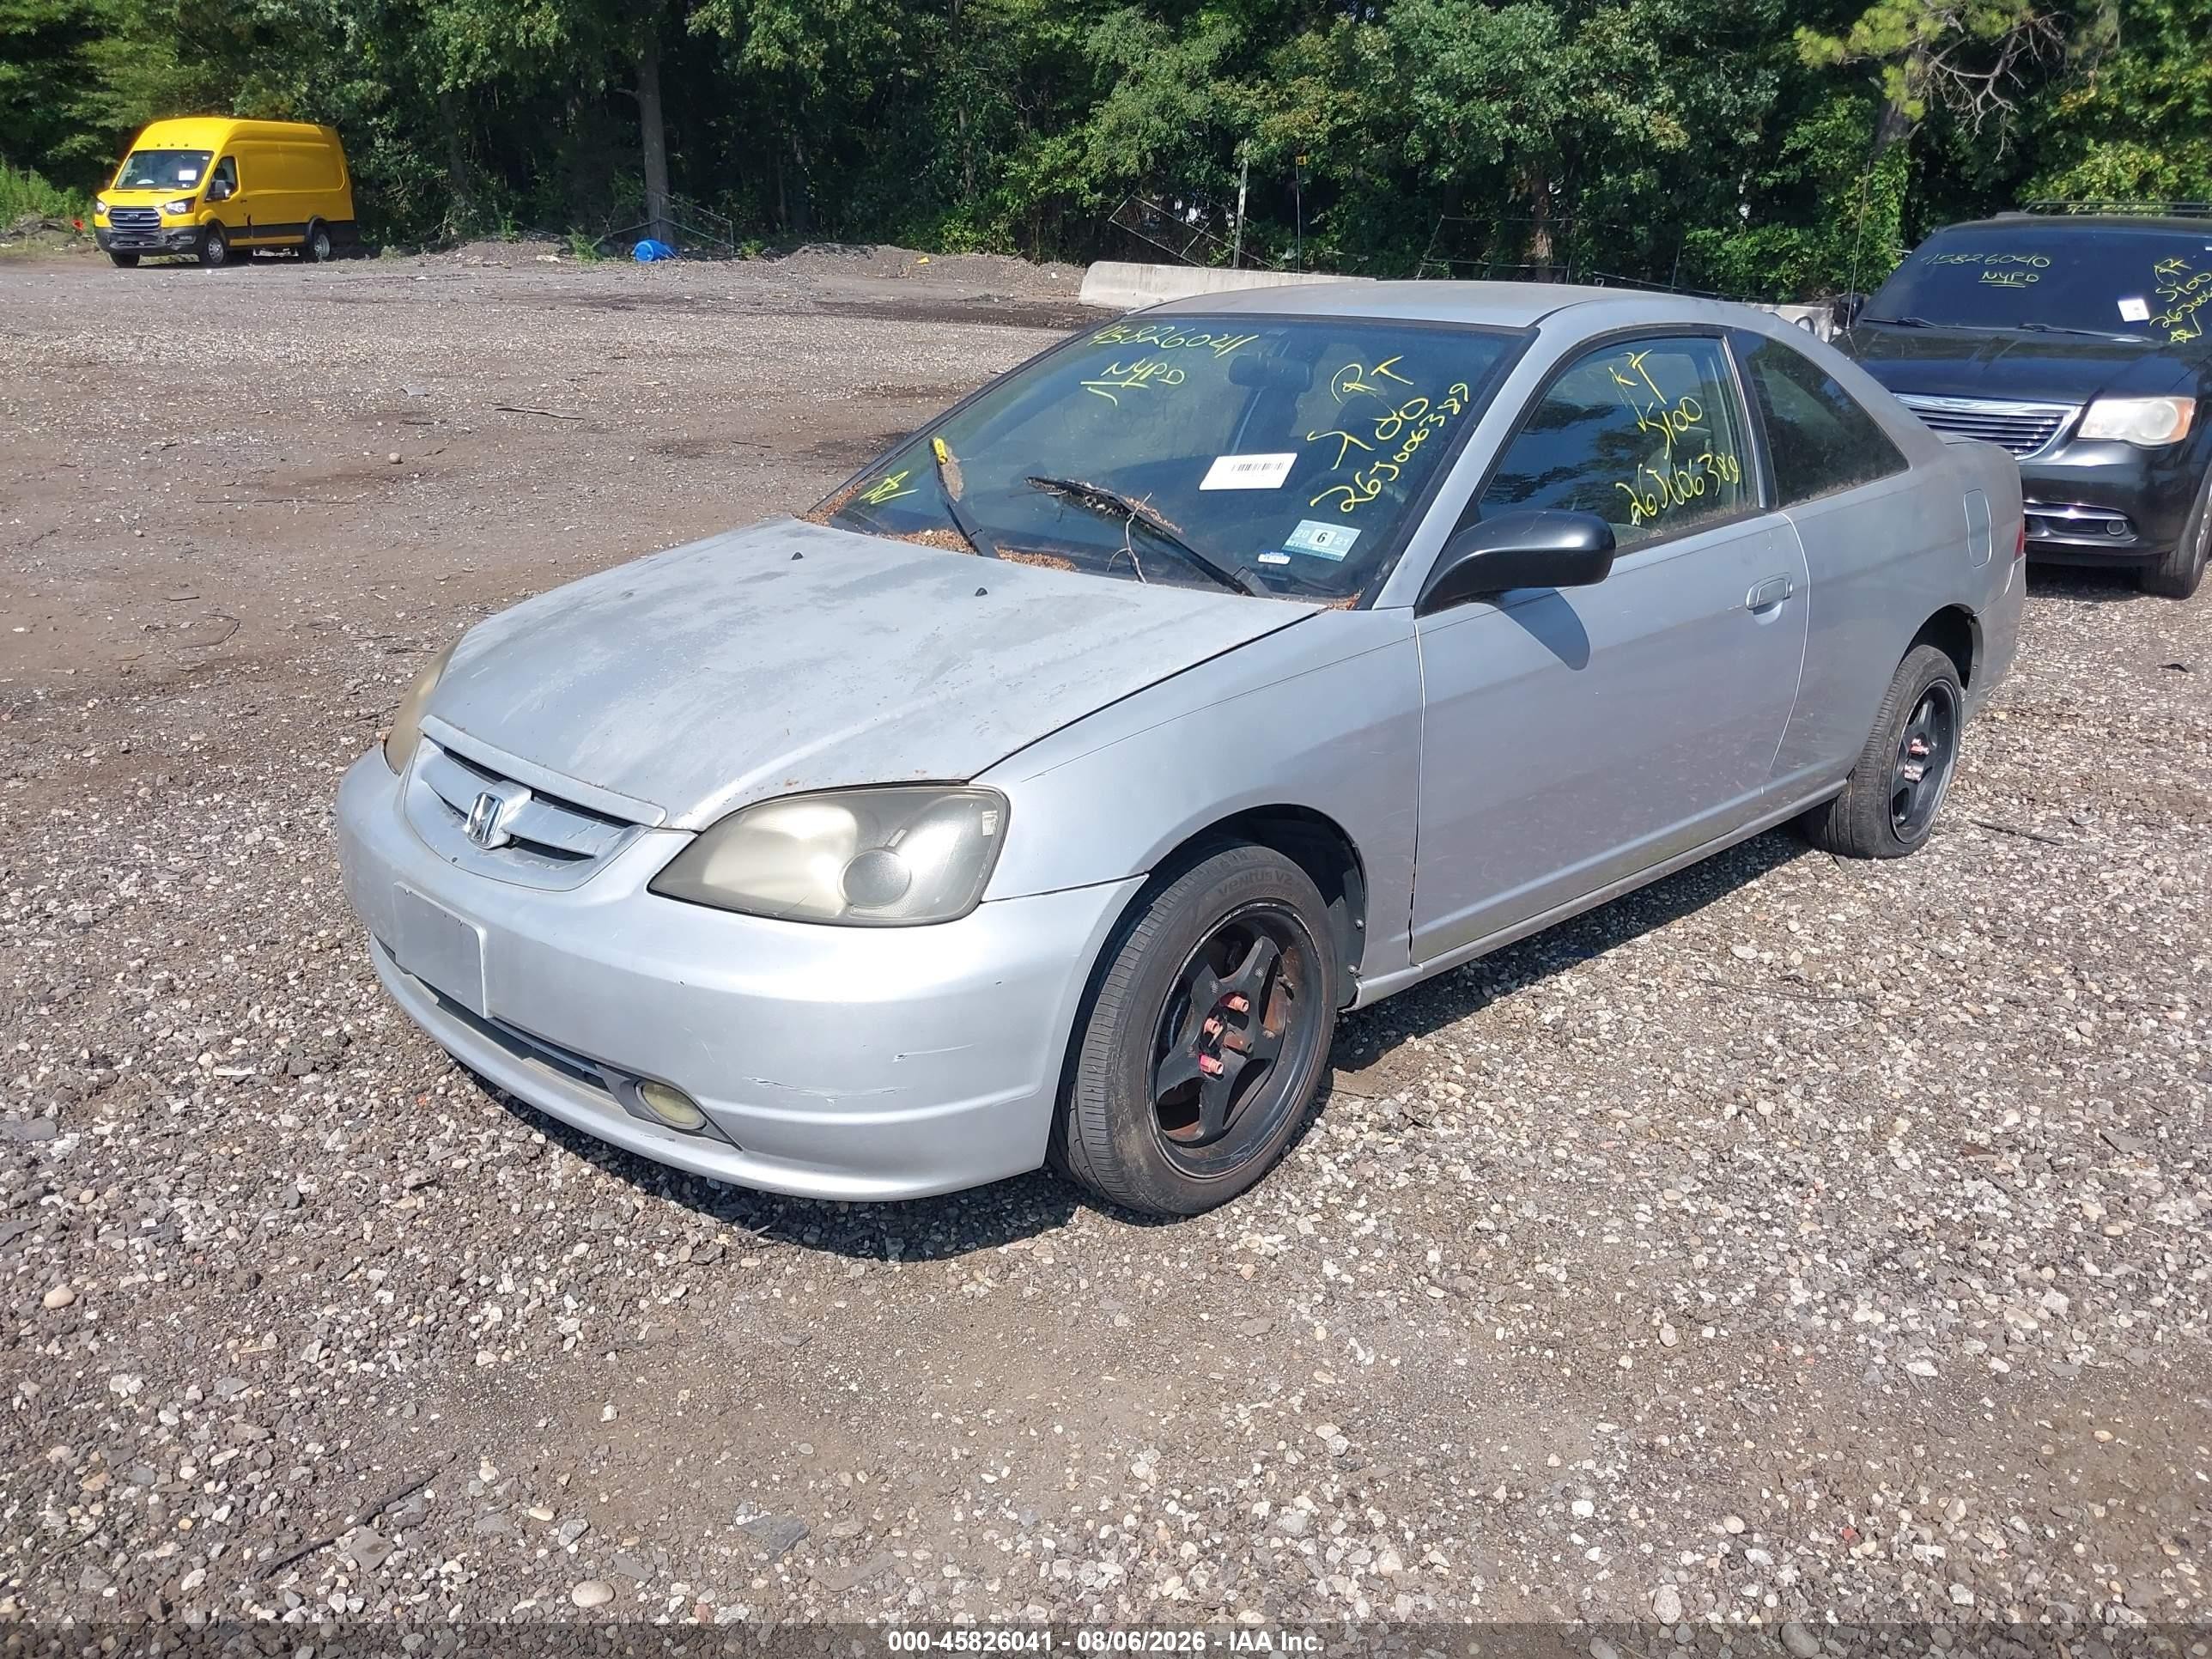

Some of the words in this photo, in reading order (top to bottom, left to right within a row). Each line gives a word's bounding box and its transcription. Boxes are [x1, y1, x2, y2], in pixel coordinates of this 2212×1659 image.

[1981, 270, 2039, 285] NYPD
[1086, 325, 1260, 359] 45826041
[1099, 357, 1186, 388] NYPD
[1316, 532, 1328, 544] 6
